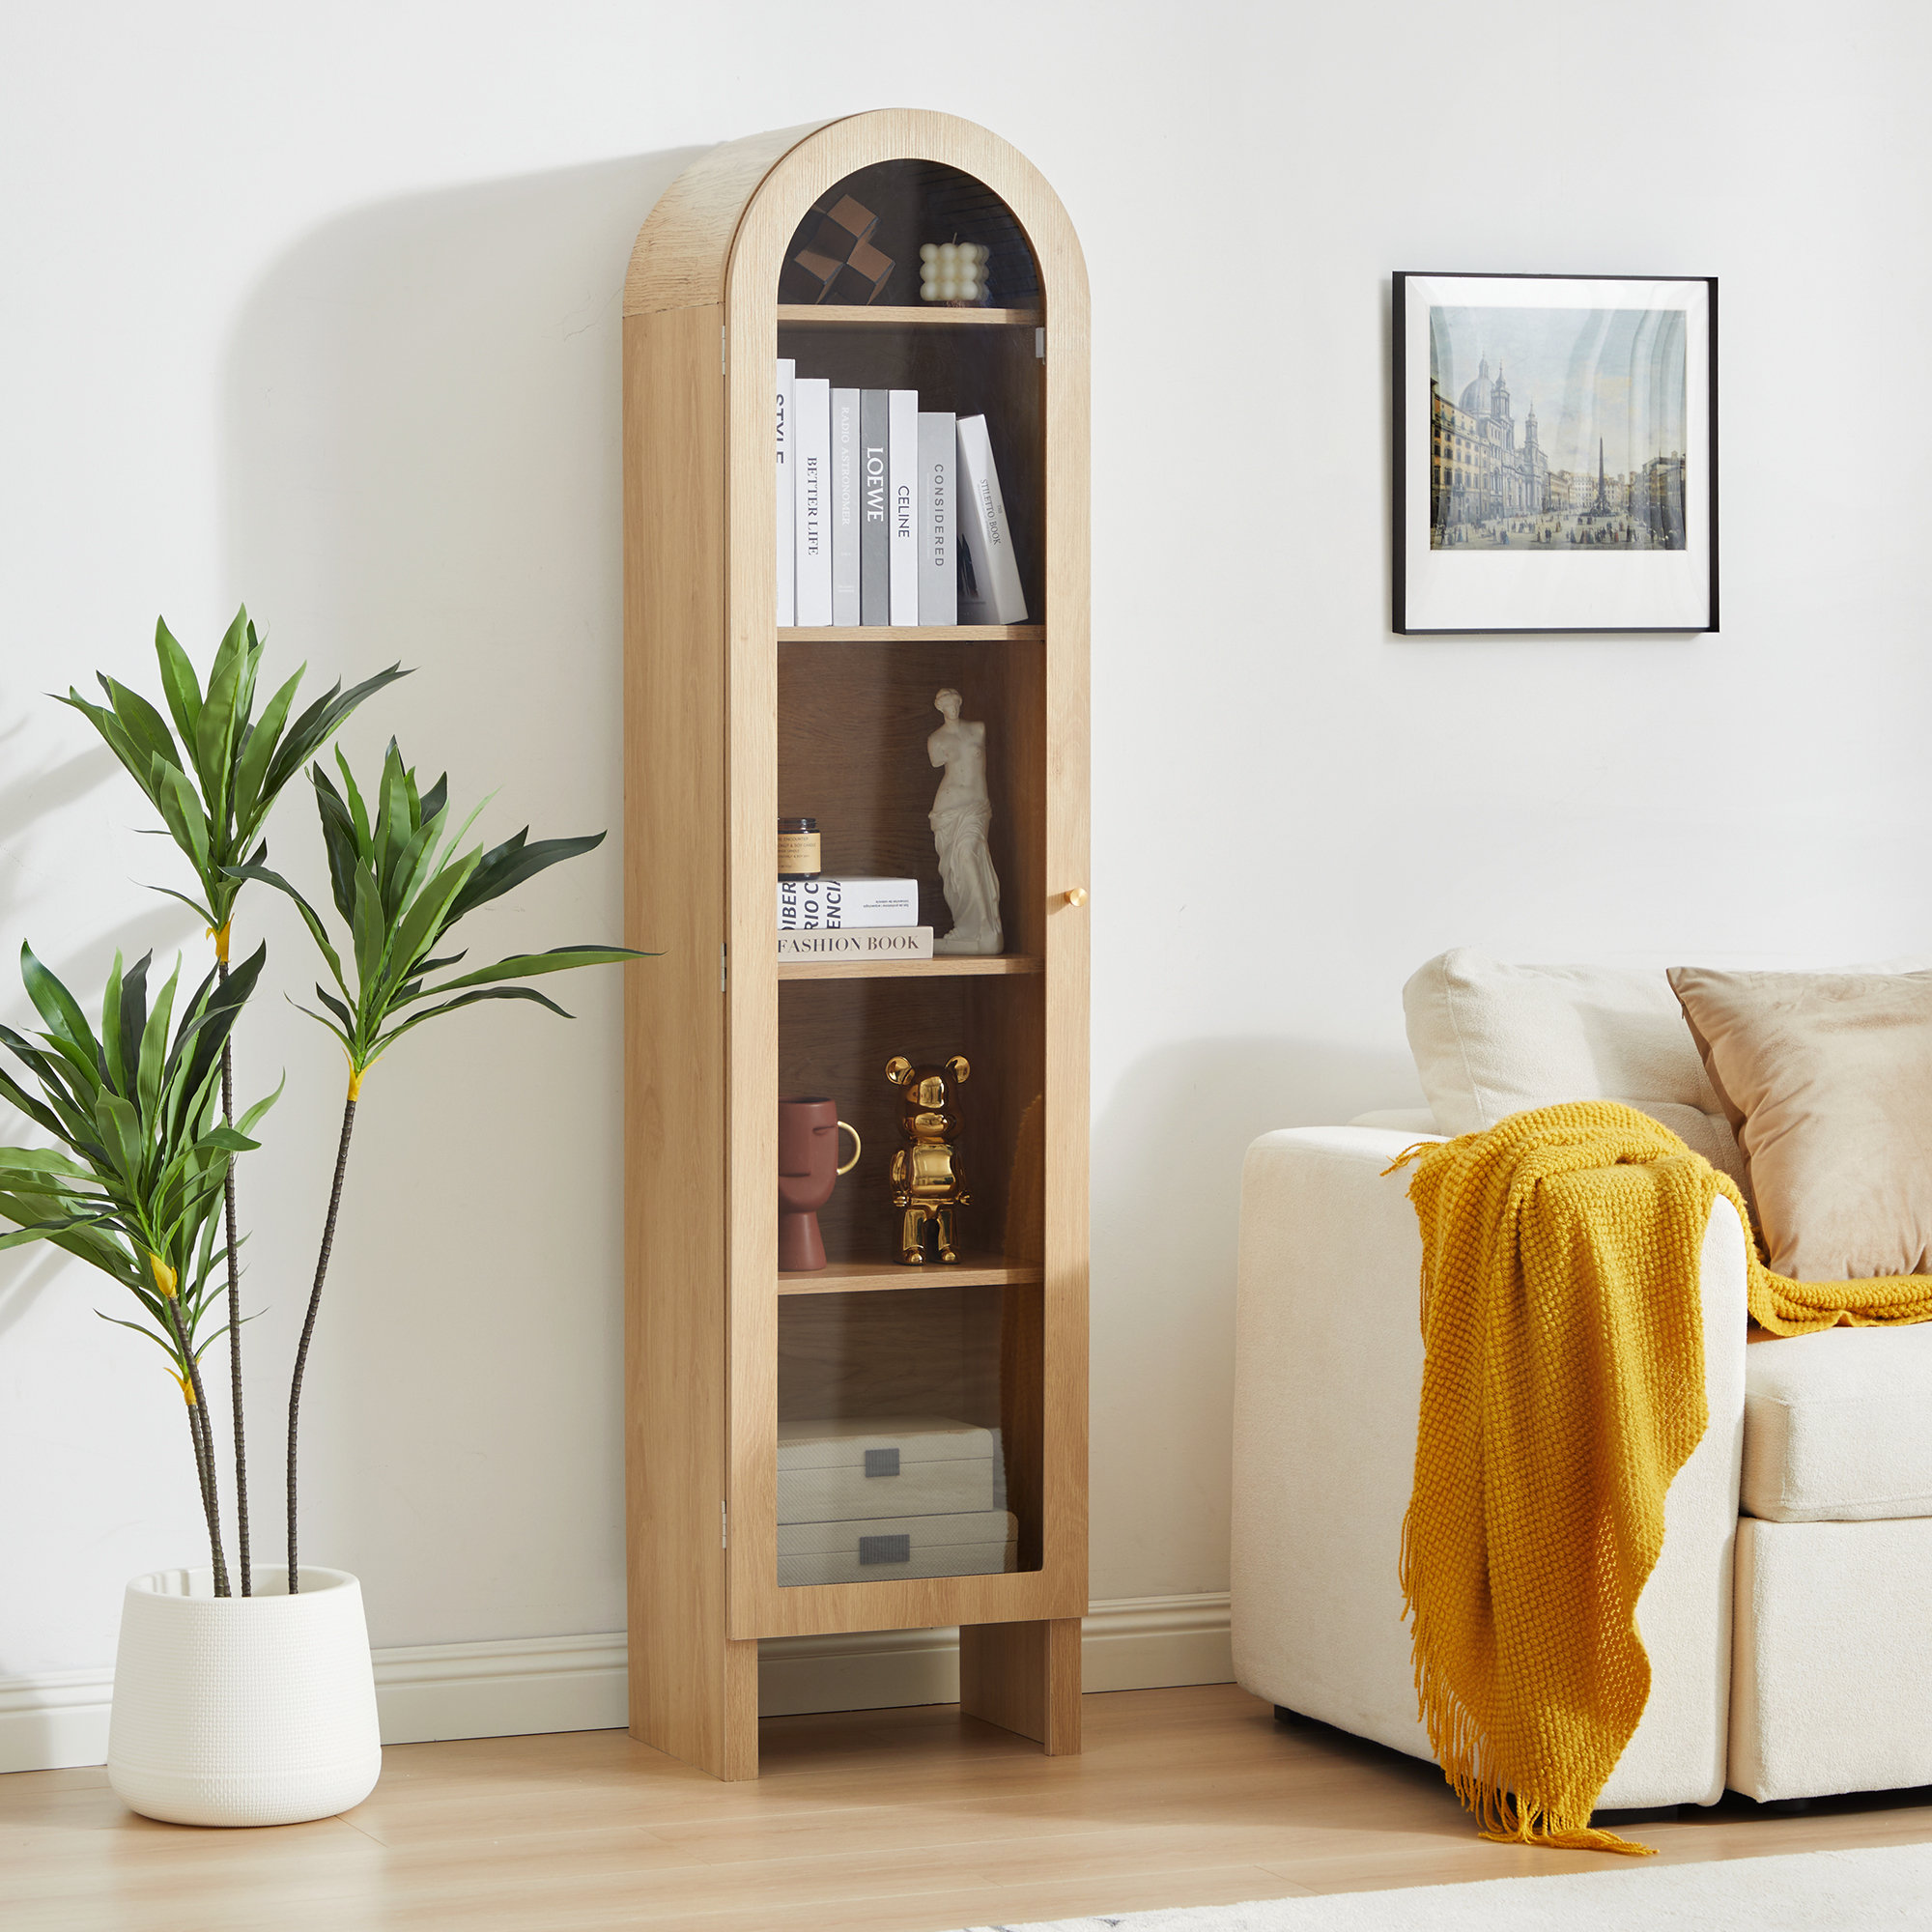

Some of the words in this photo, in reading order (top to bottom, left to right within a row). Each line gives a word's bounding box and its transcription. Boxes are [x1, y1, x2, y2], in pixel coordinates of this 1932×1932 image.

[840, 407, 850, 443] RADIO
[807, 457, 818, 517] BETTER
[841, 446, 851, 526] ASTRONOMER
[867, 446, 884, 523] LOEWE
[897, 485, 910, 538] CELINE
[934, 464, 945, 567] CONSIDERED
[980, 478, 996, 519] STILETTO
[989, 521, 1002, 545] BOOK
[808, 522, 819, 555] LIFE
[781, 882, 796, 929] IBER
[804, 899, 819, 929] RIO
[778, 937, 862, 953] FASHION
[867, 935, 920, 951] BOOK
